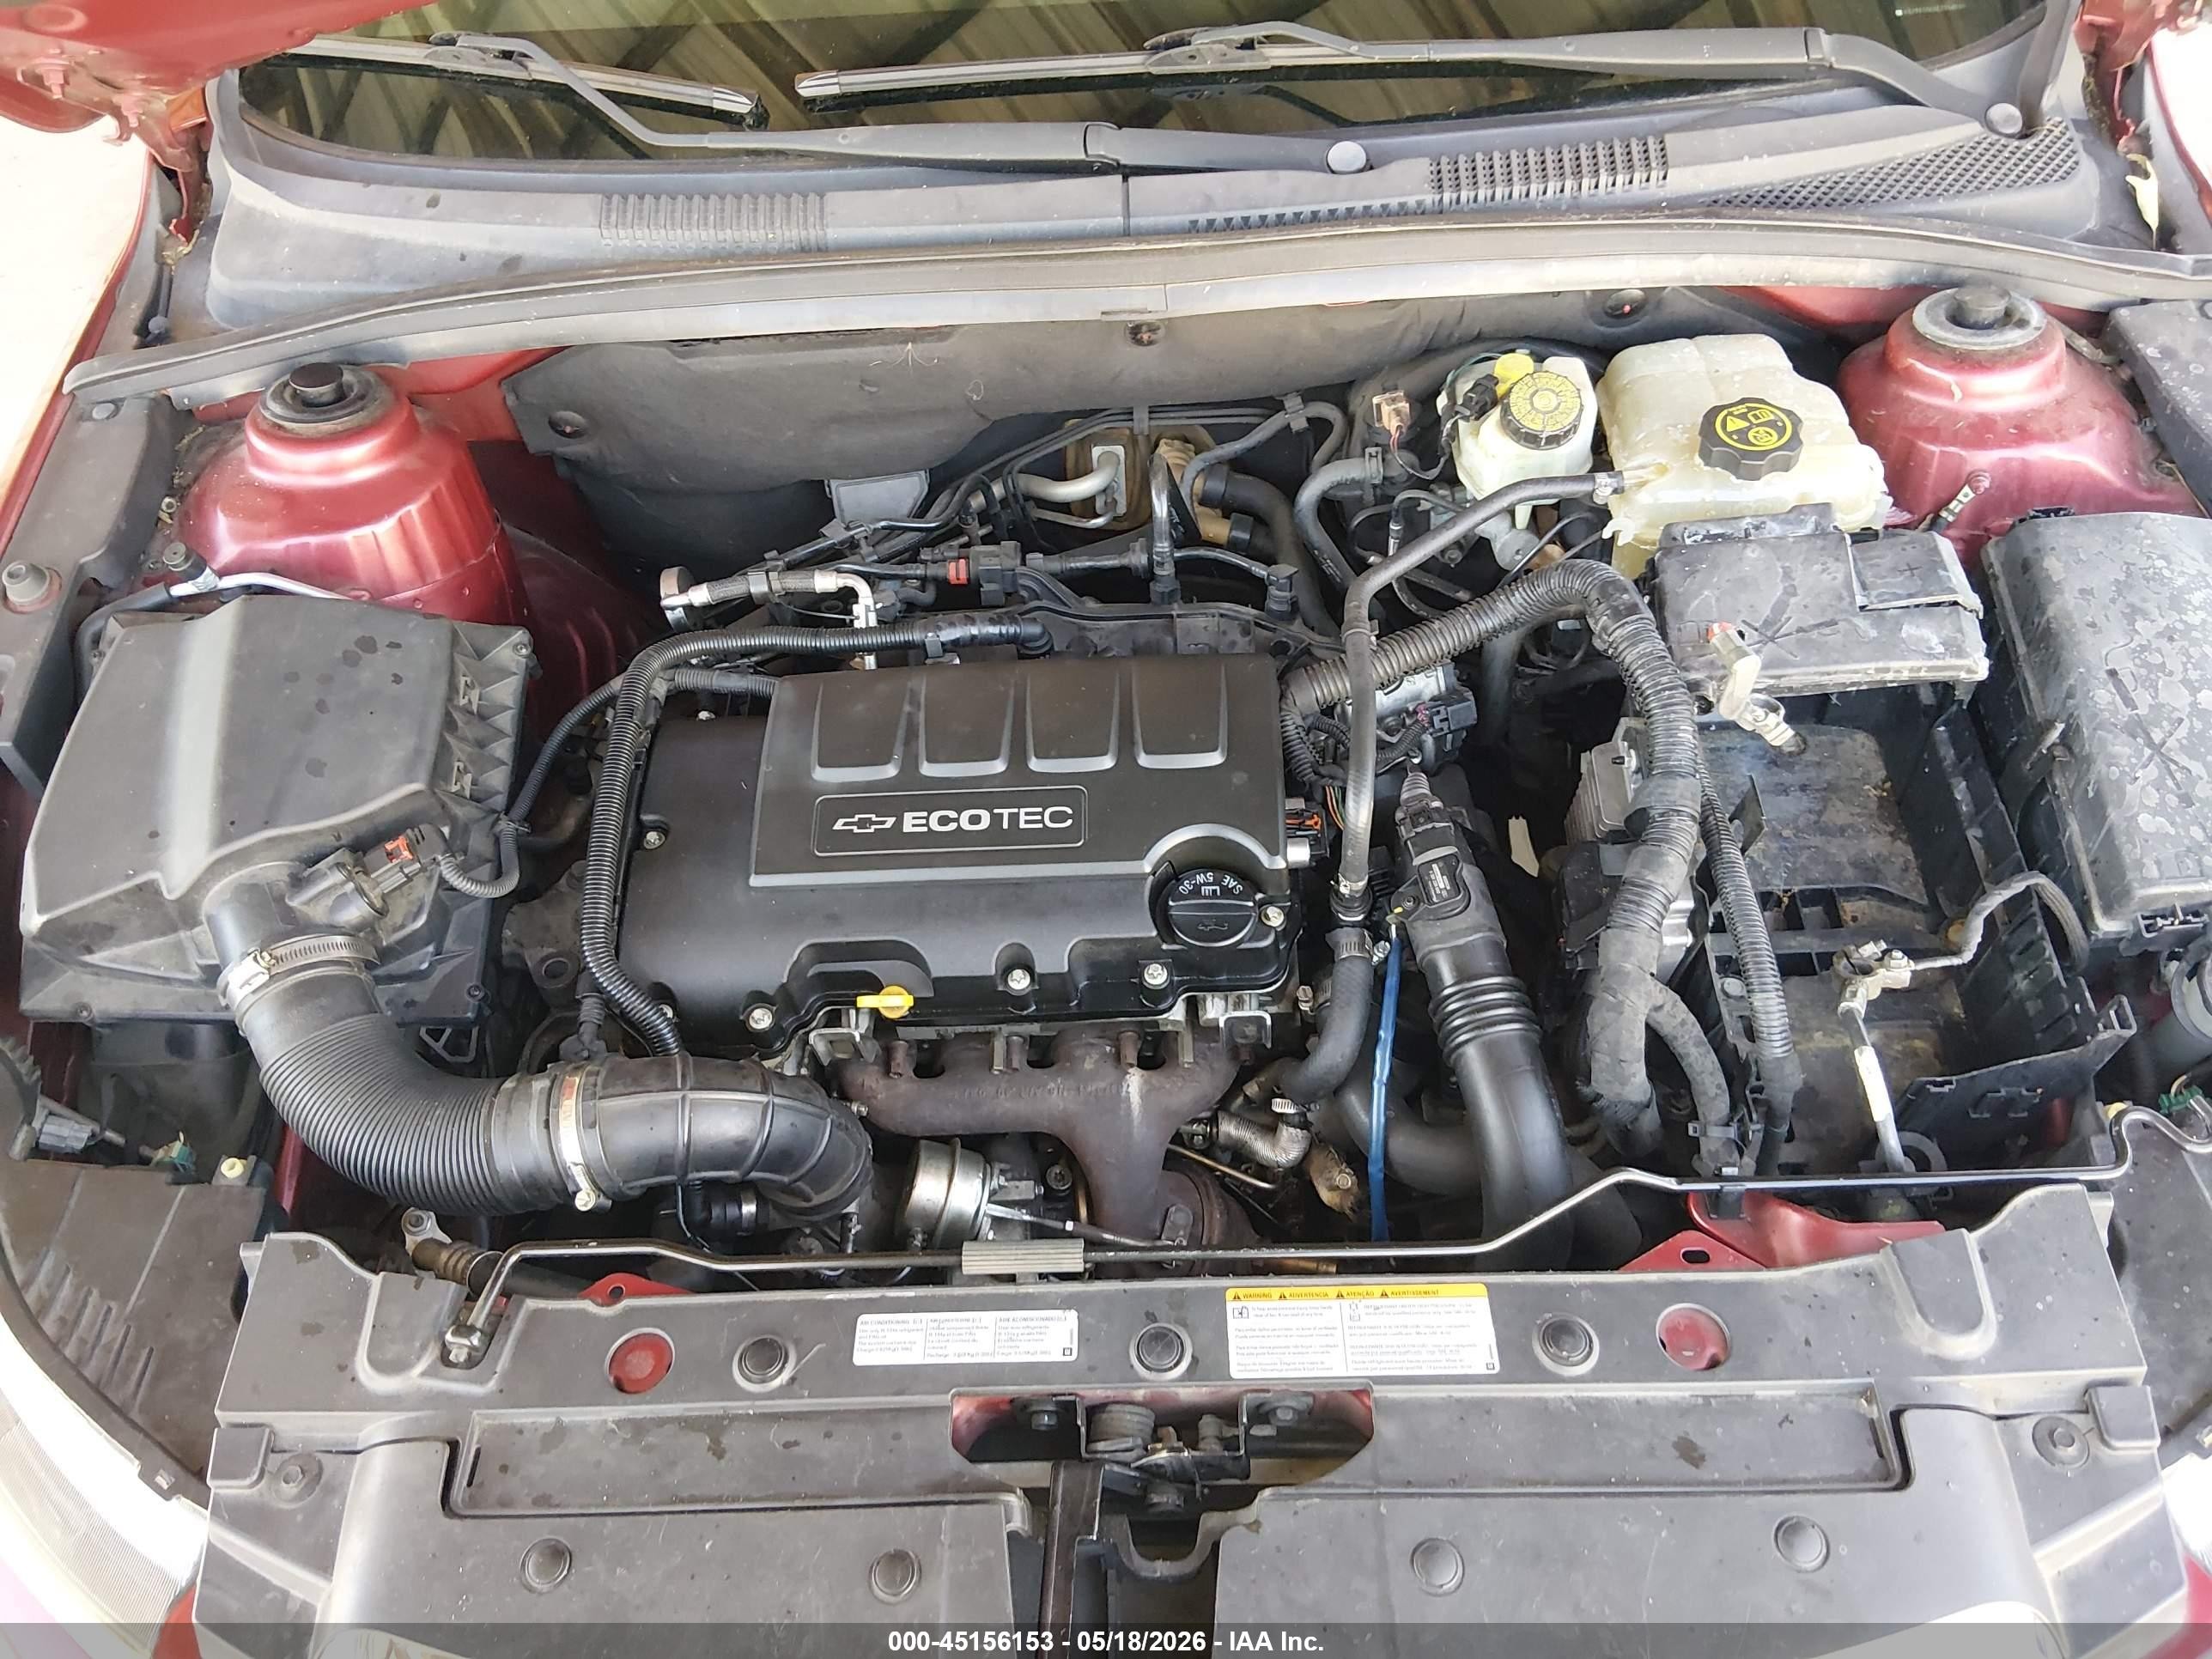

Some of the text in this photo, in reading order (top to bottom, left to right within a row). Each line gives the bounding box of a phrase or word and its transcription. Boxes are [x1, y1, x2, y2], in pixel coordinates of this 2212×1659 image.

[902, 805, 1074, 833] ECOTEC
[1178, 872, 1243, 895] SAE 5W-30
[1346, 1289, 1375, 1298] ATENÇÃO
[1390, 1288, 1439, 1297] AVERTISSEMENT
